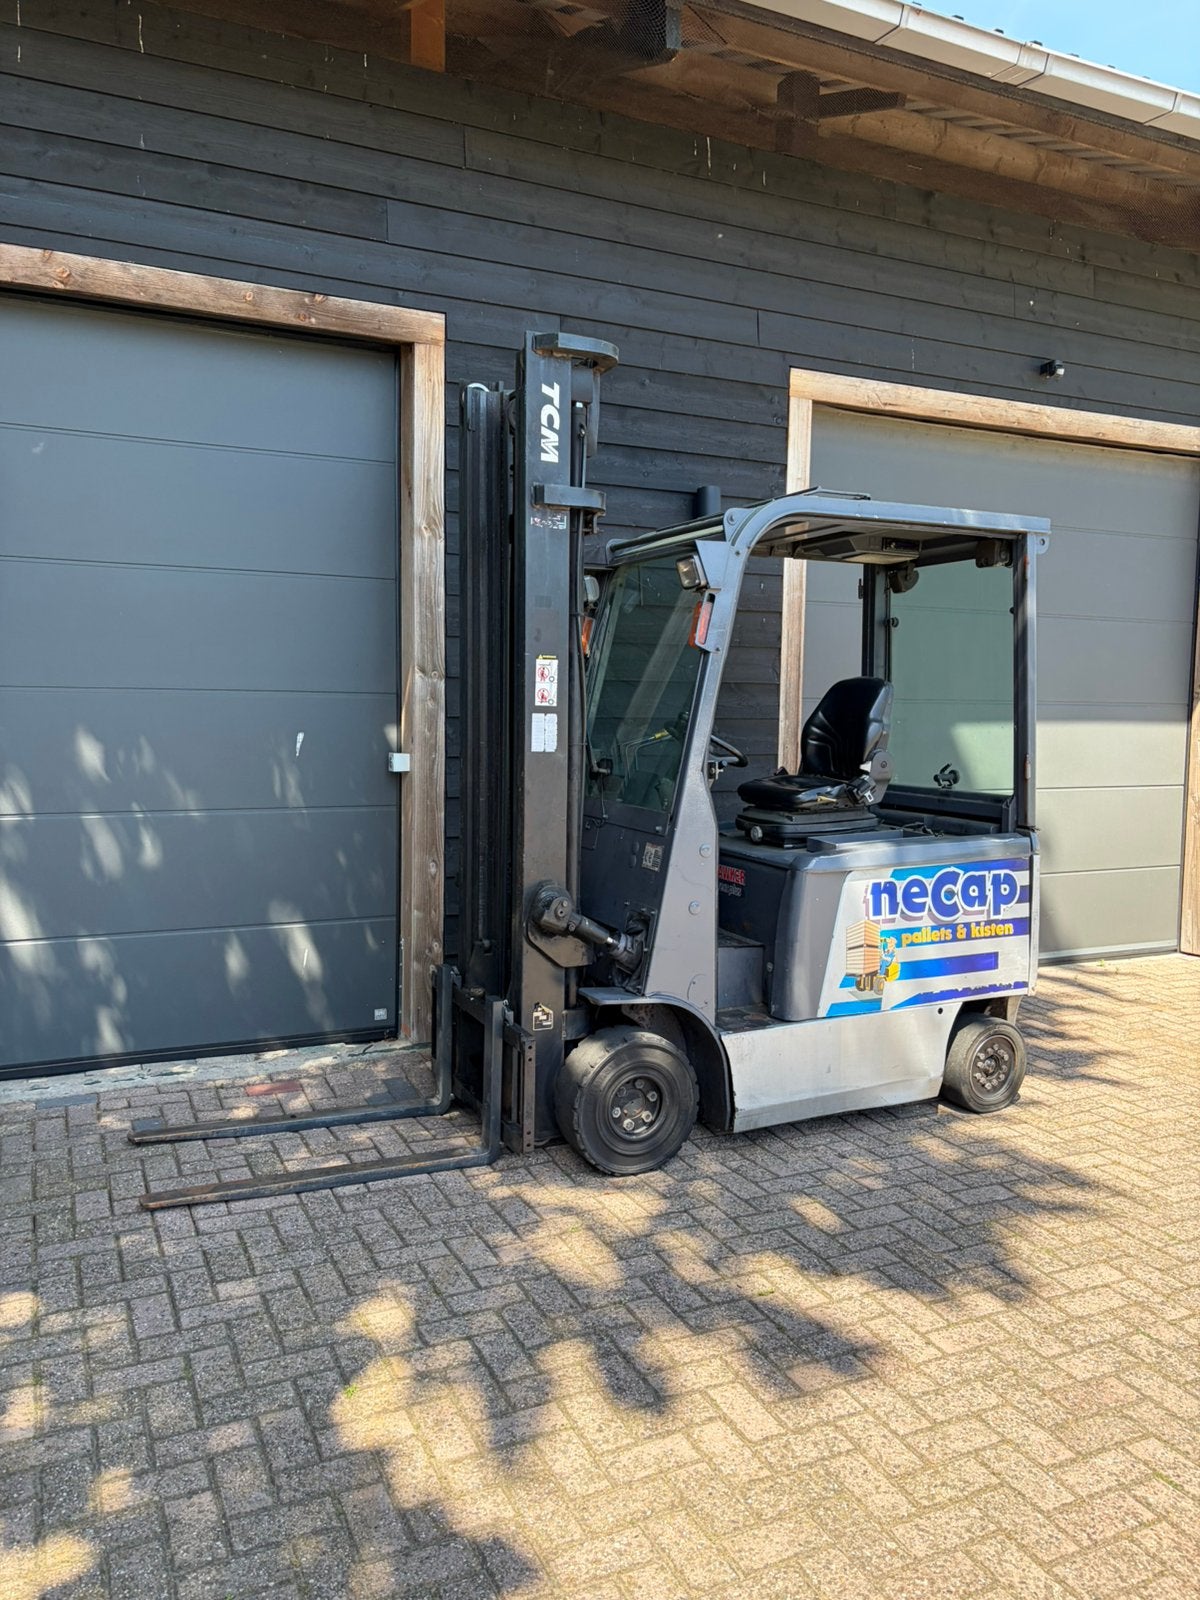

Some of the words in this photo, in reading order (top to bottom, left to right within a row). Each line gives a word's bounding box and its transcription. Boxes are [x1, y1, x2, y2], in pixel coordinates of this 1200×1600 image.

[541, 382, 560, 463] TCM
[718, 864, 746, 886] AWKER
[901, 927, 952, 947] pallets
[956, 924, 967, 939] &
[971, 922, 1014, 939] kisten
